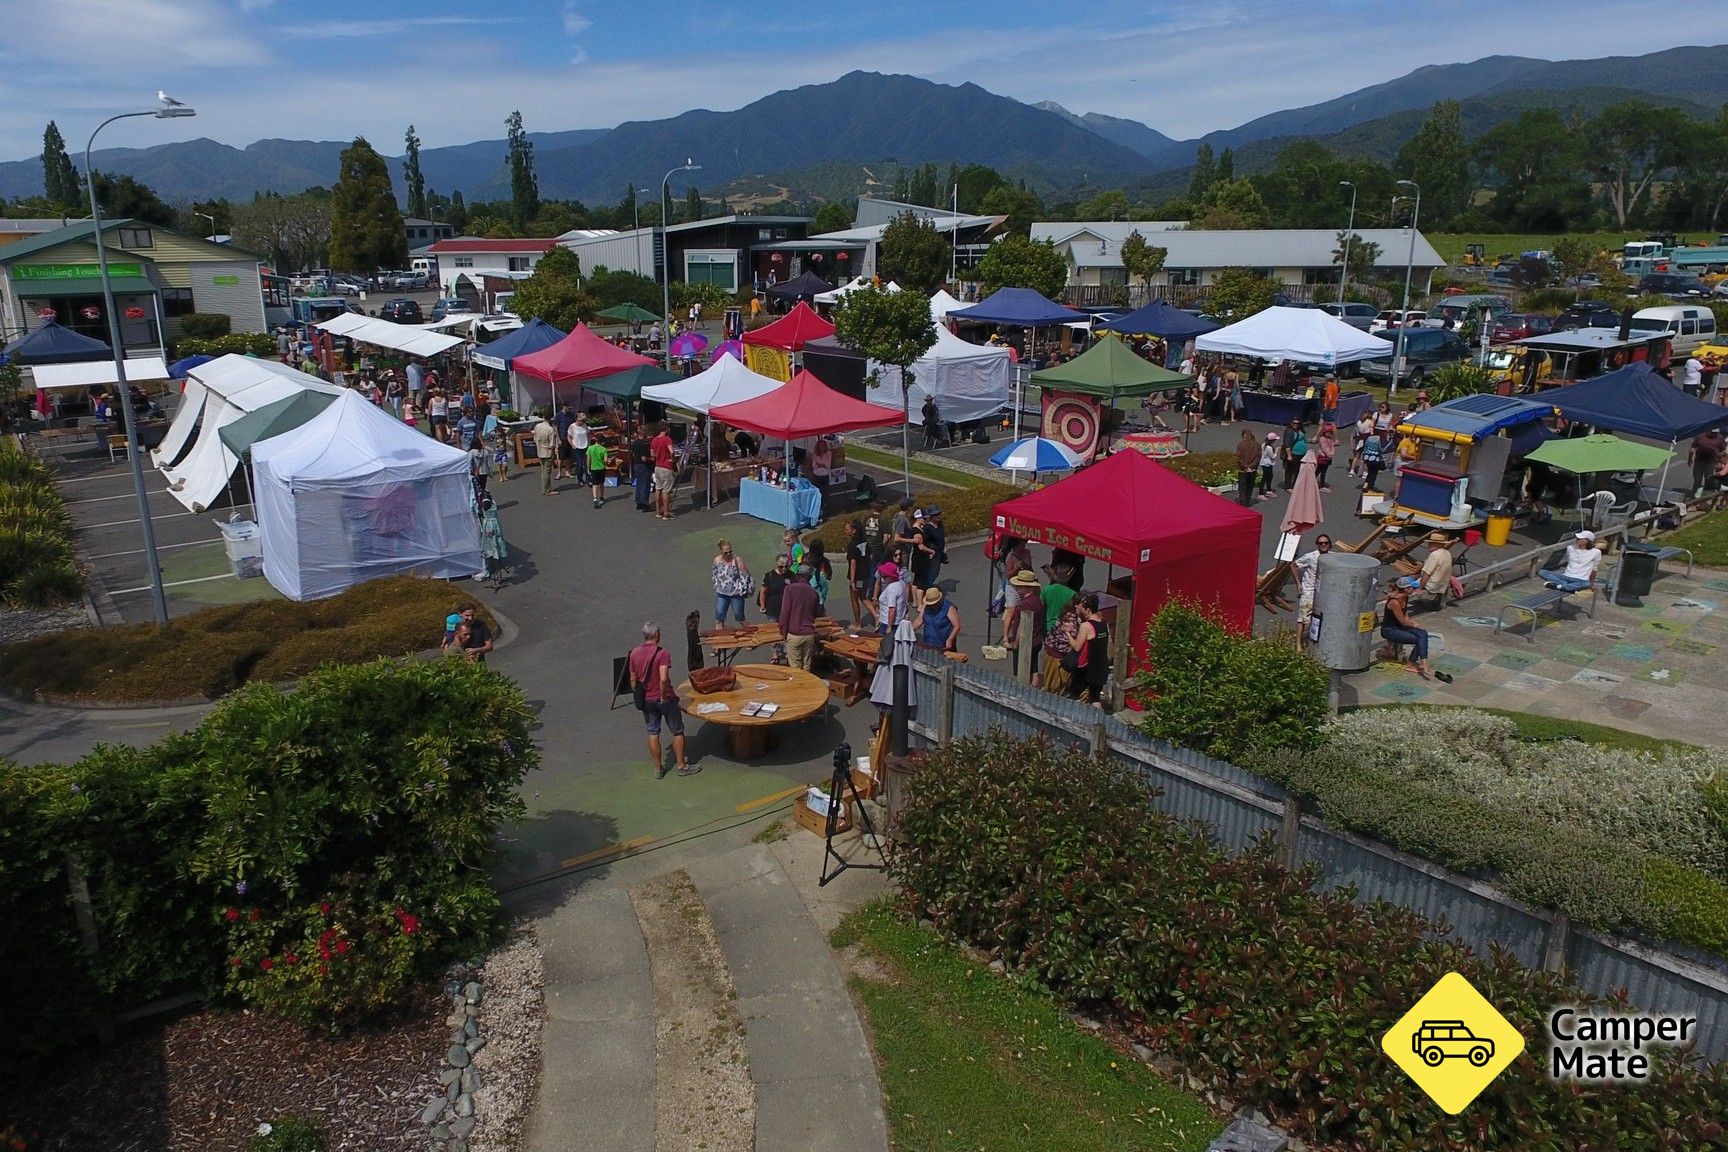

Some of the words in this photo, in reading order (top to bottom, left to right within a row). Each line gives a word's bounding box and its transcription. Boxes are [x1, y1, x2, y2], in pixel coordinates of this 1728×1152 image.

[1009, 516, 1042, 539] Vegan
[1046, 527, 1070, 546] Ice
[1075, 536, 1113, 559] Cream
